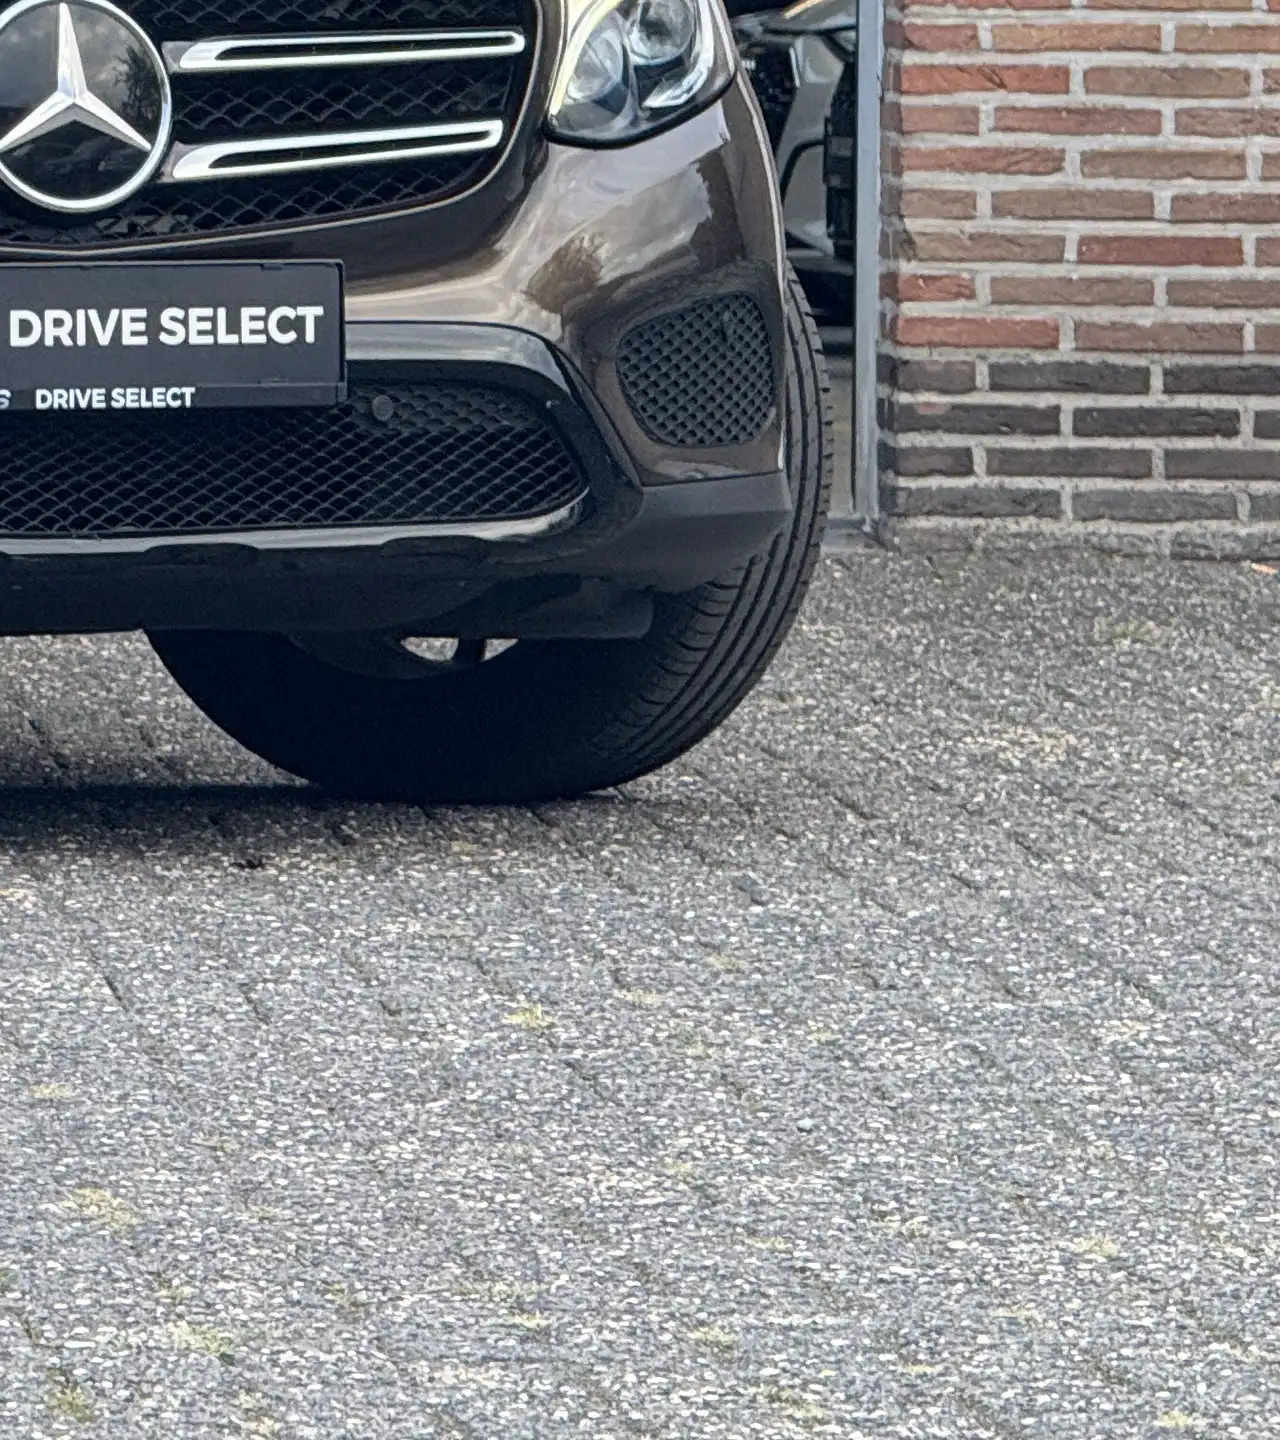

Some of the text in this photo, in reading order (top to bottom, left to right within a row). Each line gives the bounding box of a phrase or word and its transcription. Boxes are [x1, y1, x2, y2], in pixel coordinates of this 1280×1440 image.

[9, 306, 324, 347] DRIVE SELECT
[35, 387, 196, 410] DRIVE SELECT
